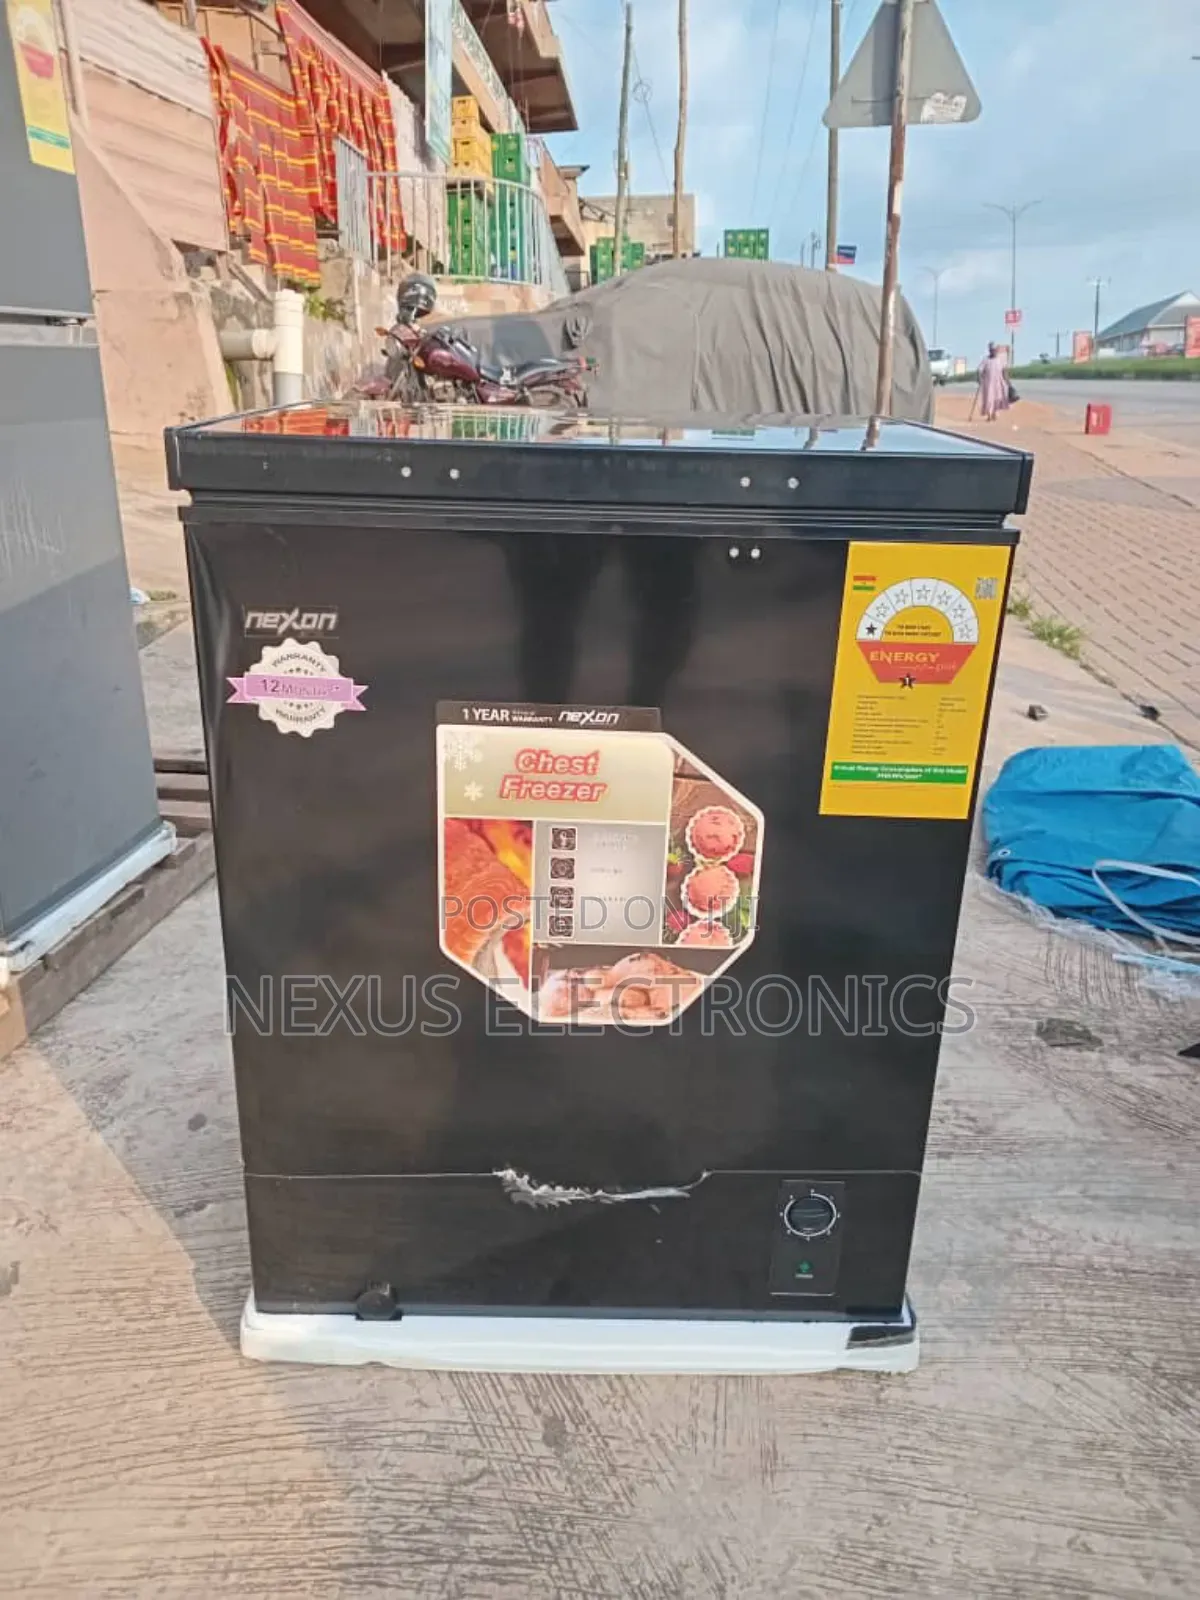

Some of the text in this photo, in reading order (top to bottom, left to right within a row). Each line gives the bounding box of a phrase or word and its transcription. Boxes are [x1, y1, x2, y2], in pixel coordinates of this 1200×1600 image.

[869, 650, 940, 664] ENERGY
[261, 679, 280, 693] 12
[462, 708, 470, 721] 1
[472, 708, 510, 722] YEAR
[514, 748, 601, 775] Chest
[499, 774, 607, 803] Freezer
